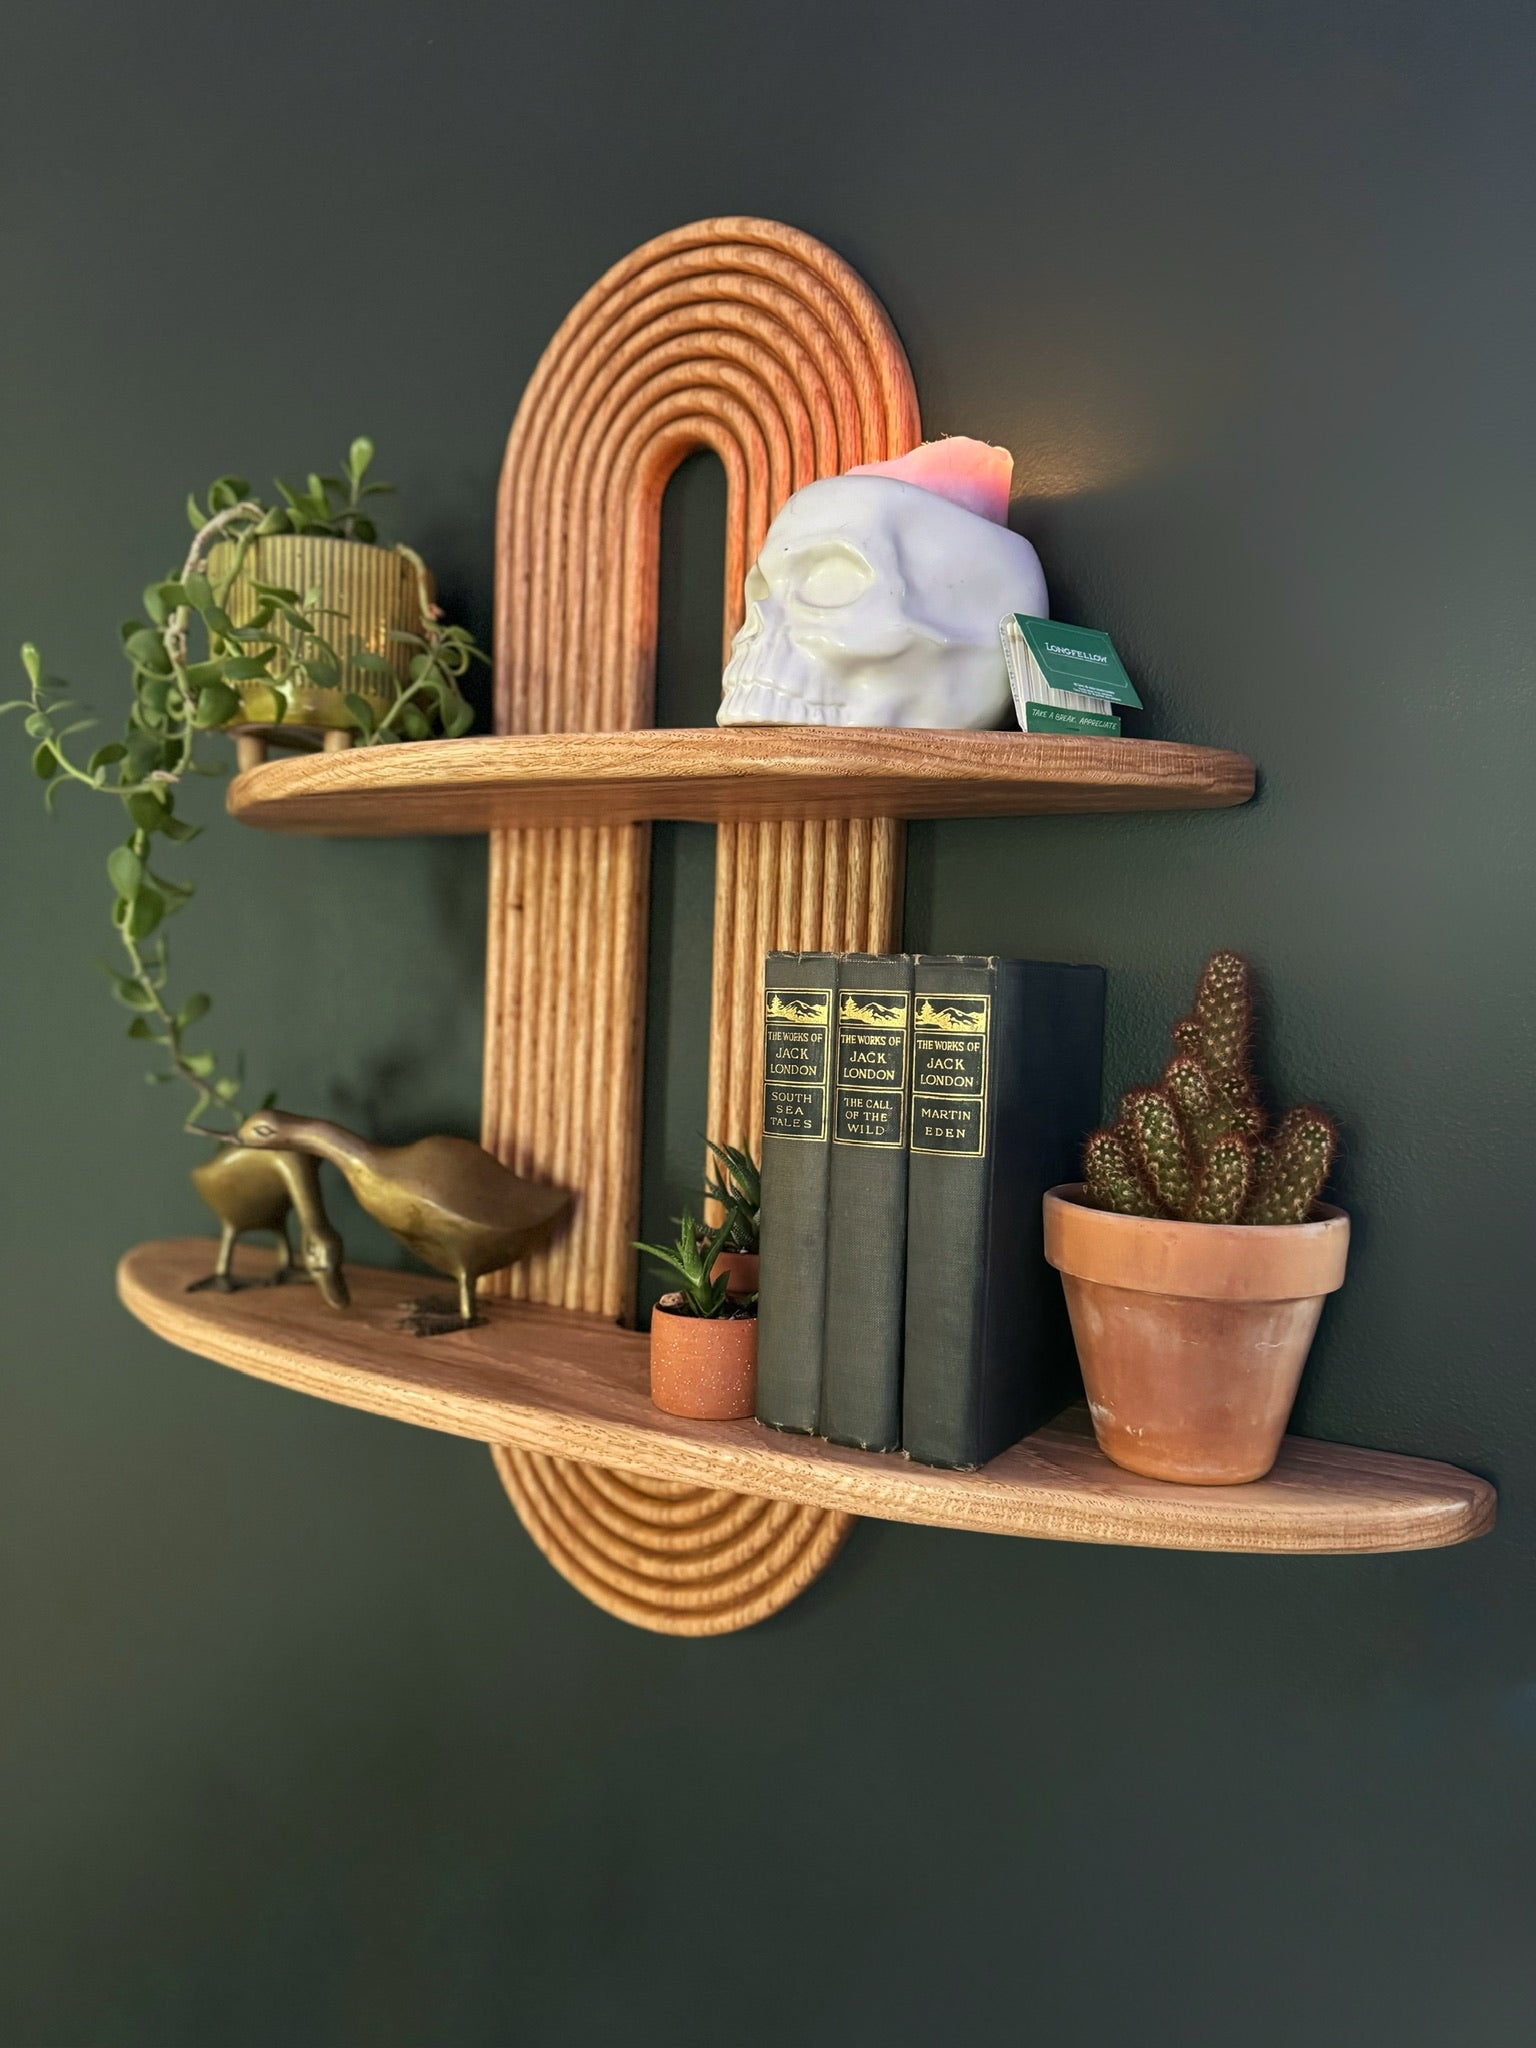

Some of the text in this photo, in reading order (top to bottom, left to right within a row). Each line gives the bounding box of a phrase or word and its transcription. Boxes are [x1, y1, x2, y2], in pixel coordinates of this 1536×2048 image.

[1032, 708, 1048, 718] TAKE
[1048, 712, 1054, 720] A
[1079, 717, 1118, 730] APPRECIATE
[768, 1031, 823, 1043] THE WORKS OF
[841, 1034, 901, 1047] THE WORKS OF
[917, 1039, 981, 1052] THE WORKS OF
[775, 1047, 809, 1060] JACK
[850, 1051, 887, 1064] JACK
[770, 1064, 817, 1076] LONDON
[926, 1057, 965, 1071] JACK
[843, 1067, 895, 1081] LONDON
[920, 1074, 974, 1088] LONDON
[771, 1091, 812, 1104] SOUTH
[843, 1098, 893, 1110] THE CALL
[775, 1105, 804, 1116] SEA
[845, 1111, 888, 1122] OF THE
[921, 1108, 971, 1121] MARTIN
[770, 1117, 812, 1129] TALES
[848, 1123, 885, 1136] WILD
[925, 1126, 966, 1138] EDEN
